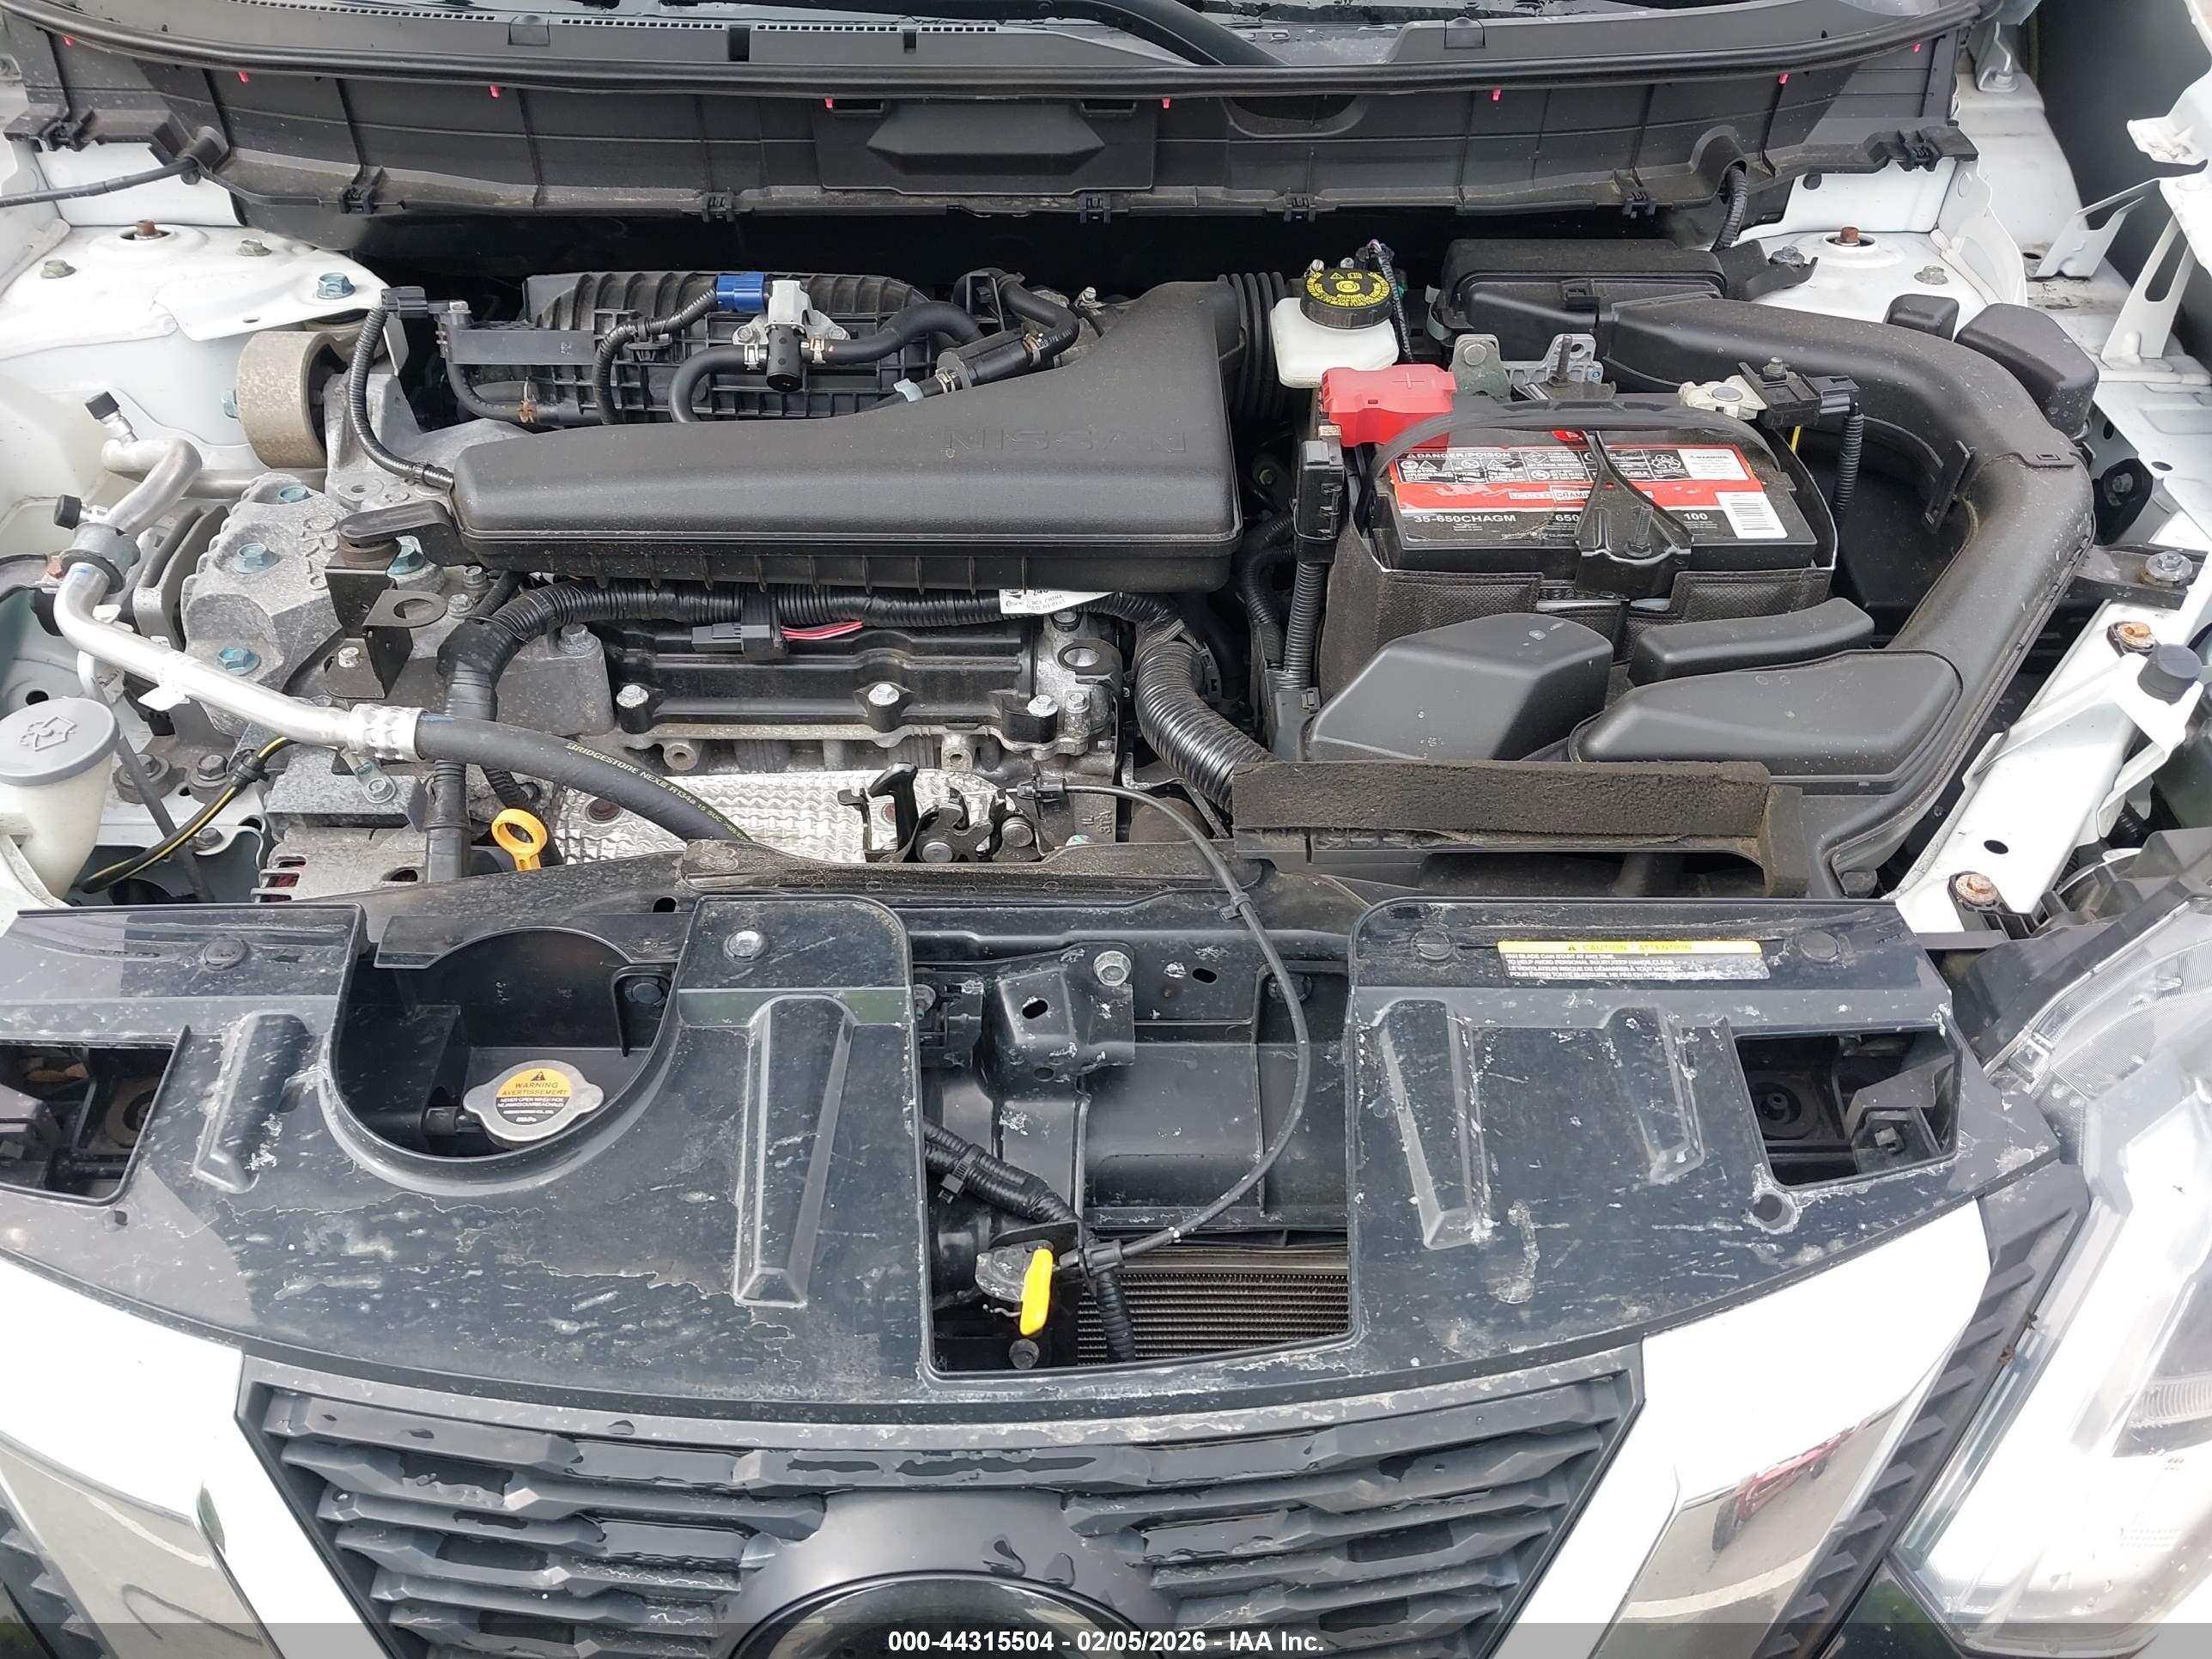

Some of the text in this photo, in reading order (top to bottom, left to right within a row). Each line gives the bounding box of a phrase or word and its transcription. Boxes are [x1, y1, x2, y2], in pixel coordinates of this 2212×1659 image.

[947, 429, 1187, 453] NISSAN
[1414, 514, 1516, 523] 35-650CHAGM
[564, 742, 640, 774] BRIDGESTONE
